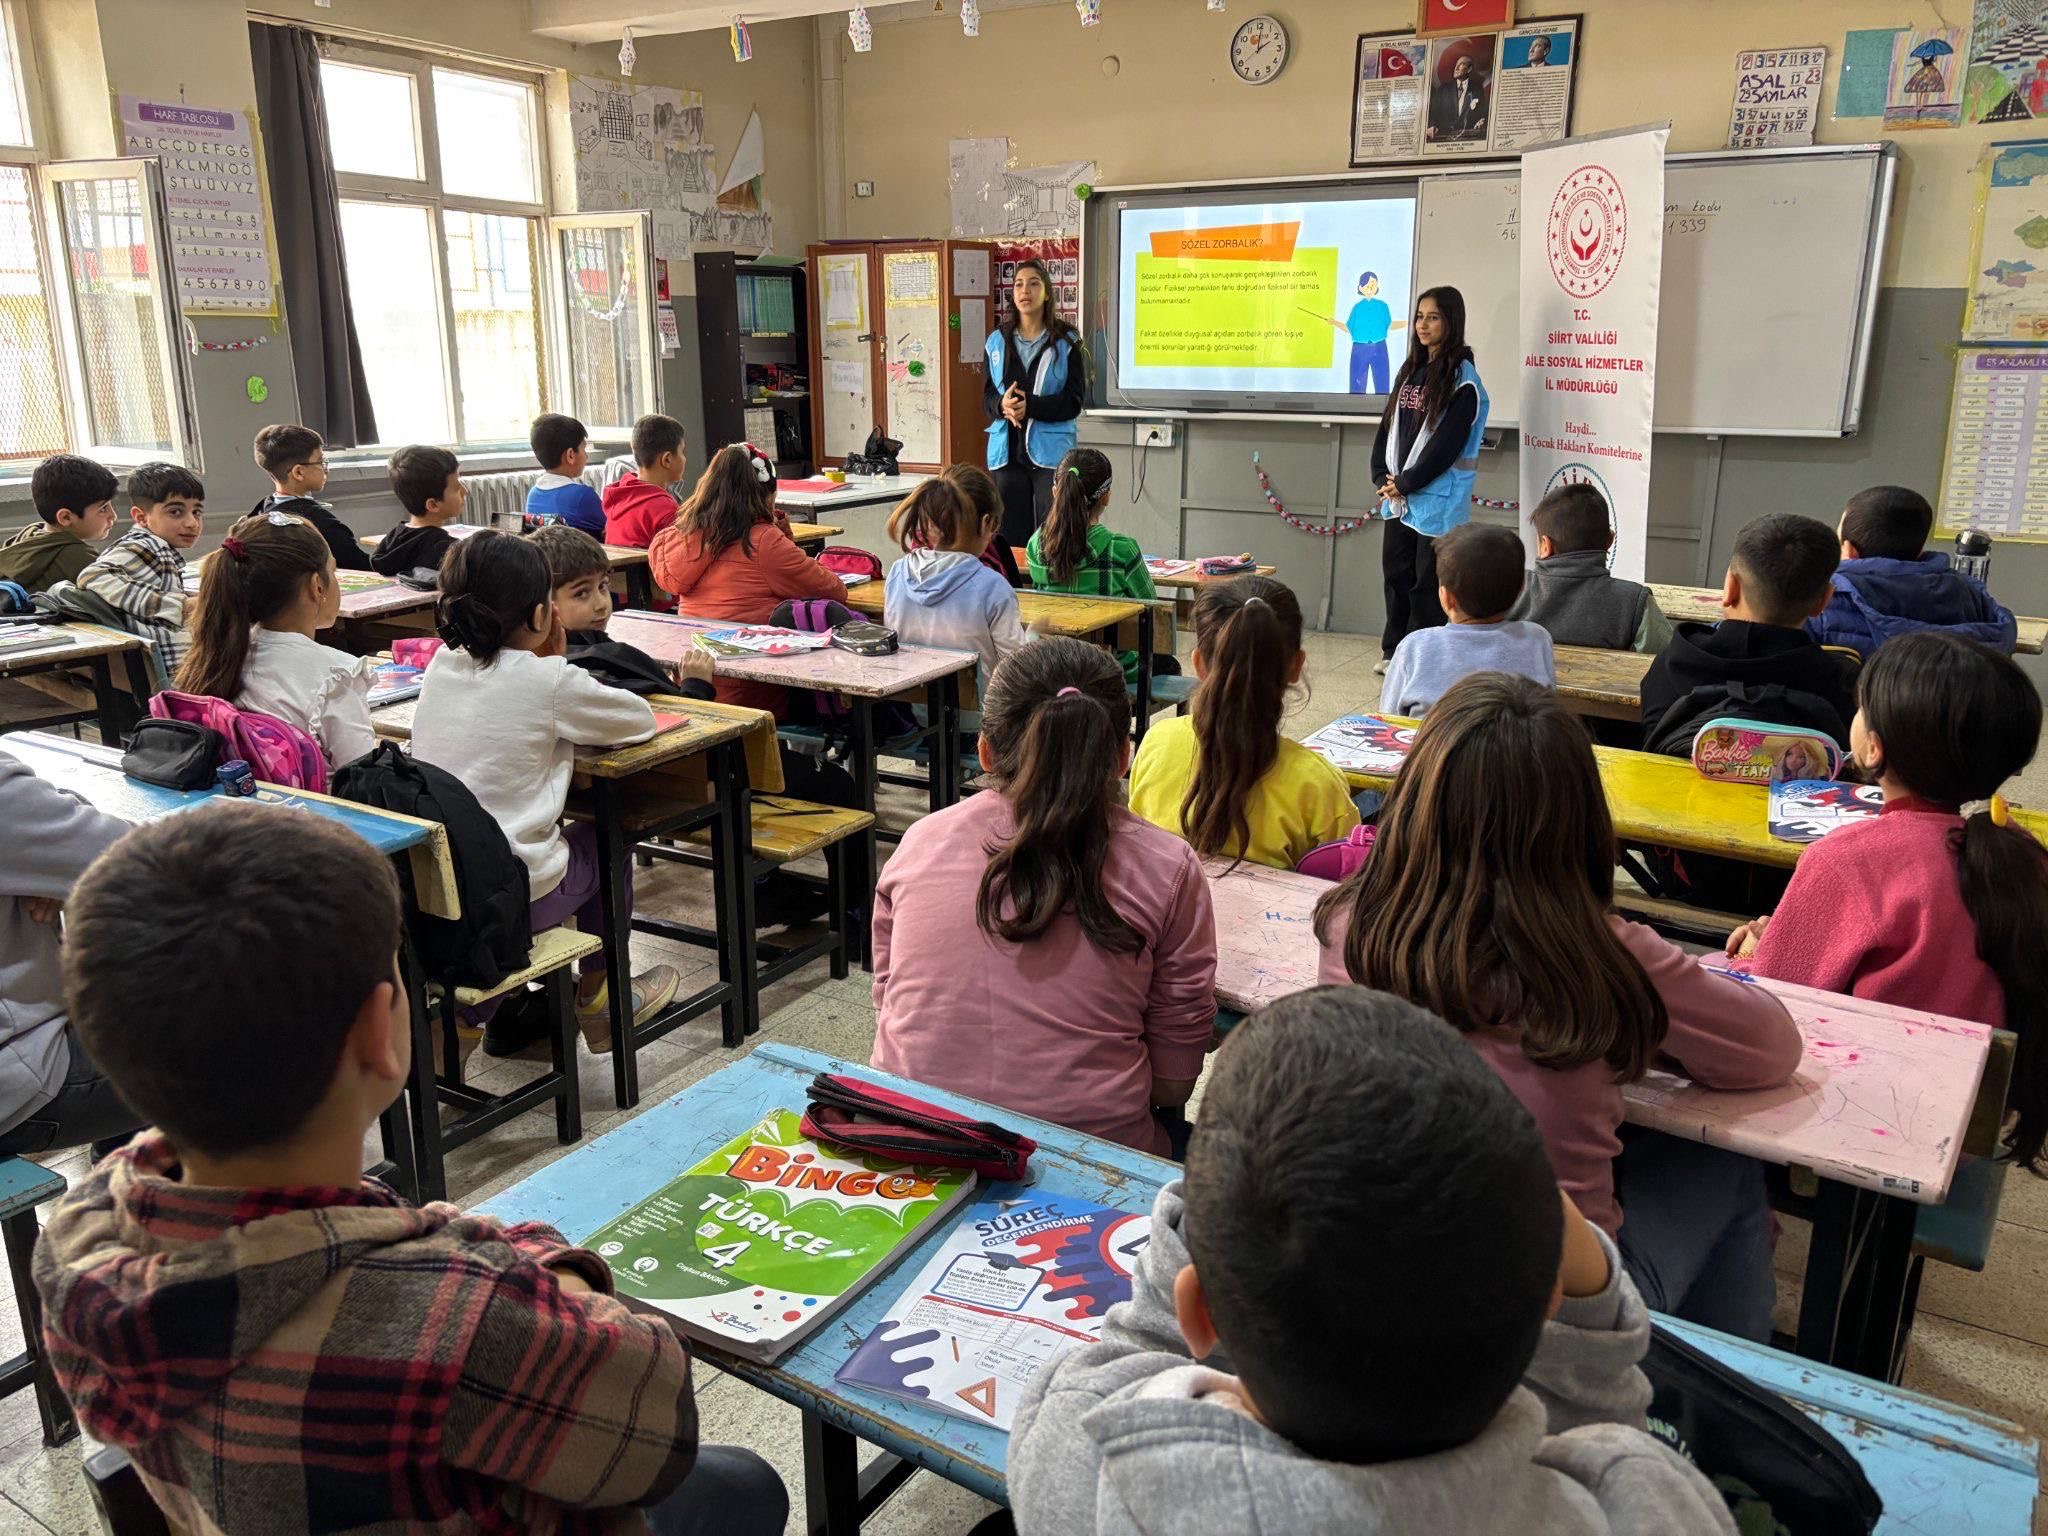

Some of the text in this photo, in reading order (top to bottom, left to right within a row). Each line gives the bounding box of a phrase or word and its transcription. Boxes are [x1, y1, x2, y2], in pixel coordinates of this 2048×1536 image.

[1257, 21, 1264, 30] 12
[1740, 70, 1820, 88] ASAL 23
[1752, 86, 1807, 104] SAYILAR
[154, 109, 219, 125] HARF TABLOSU
[129, 136, 249, 157] A B C Ç D E F G Ğ
[164, 158, 251, 176] J K L M N O Ö
[170, 177, 253, 194] Ş T U Ü V Y Z
[1501, 228, 1516, 240] 56
[1182, 238, 1264, 250] SÖZEL ZORBALIK?
[1141, 272, 1158, 280] Sözel
[1199, 272, 1210, 280] çok
[1211, 272, 1243, 280] konuşarak
[1292, 270, 1318, 278] zorbalık
[184, 278, 265, 291] 4 5 6 7 8 9 0
[1236, 282, 1266, 292] doğrudan
[1300, 282, 1320, 290] temas
[1574, 309, 1590, 320] T.C.
[1140, 330, 1158, 338] Fakat
[1184, 330, 1212, 340] duygusal
[1214, 330, 1235, 340] açıdan
[1548, 331, 1617, 345] SİİRT VALİLİĞİ
[1140, 343, 1160, 352] önemli
[1525, 354, 1643, 372] AİLE SOSYAL HİZMETLER
[1999, 358, 2039, 366] ANLAMLI
[1545, 377, 1618, 394] İL MÜDÜRLÜĞÜ
[1566, 422, 1596, 437] Haydi...
[1524, 433, 1642, 461] İl Çocuk Hakları Komitelerine
[1701, 739, 1751, 762] Barbie
[1734, 766, 1771, 778] TEAM
[698, 1193, 832, 1256] TÜRKÇE
[975, 1203, 1064, 1237] SÜREÇ
[986, 1214, 1095, 1247] DEĞERLENDİRME
[702, 1240, 752, 1270] 4
[971, 1276, 986, 1284] Sınav
